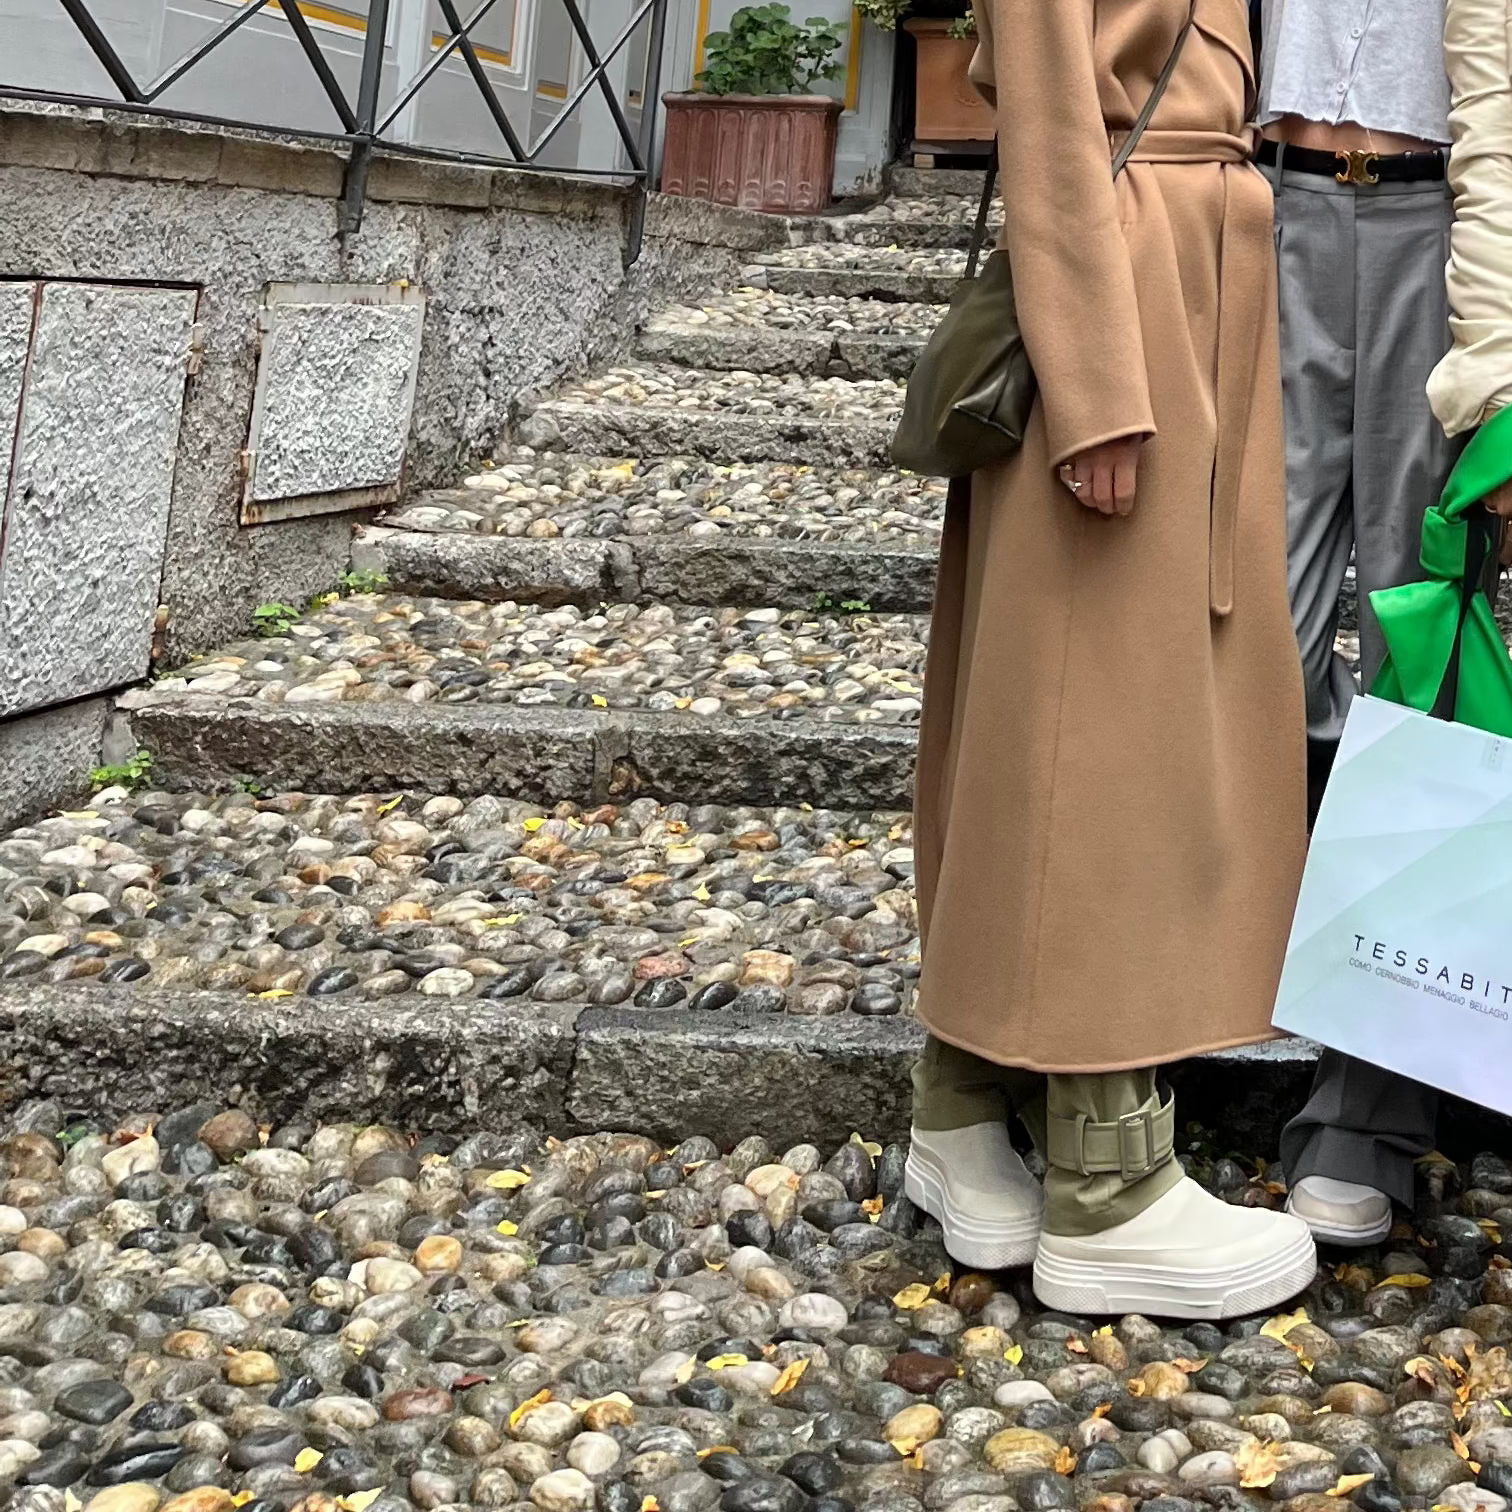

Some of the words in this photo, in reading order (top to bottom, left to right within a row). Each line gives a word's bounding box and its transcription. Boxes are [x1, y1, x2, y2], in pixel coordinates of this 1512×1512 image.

[1348, 957, 1372, 973] COMO
[1375, 966, 1420, 990] CERNOBBIO
[1423, 984, 1466, 1006] MENAGGIO
[1469, 999, 1509, 1021] BELLAGIO
